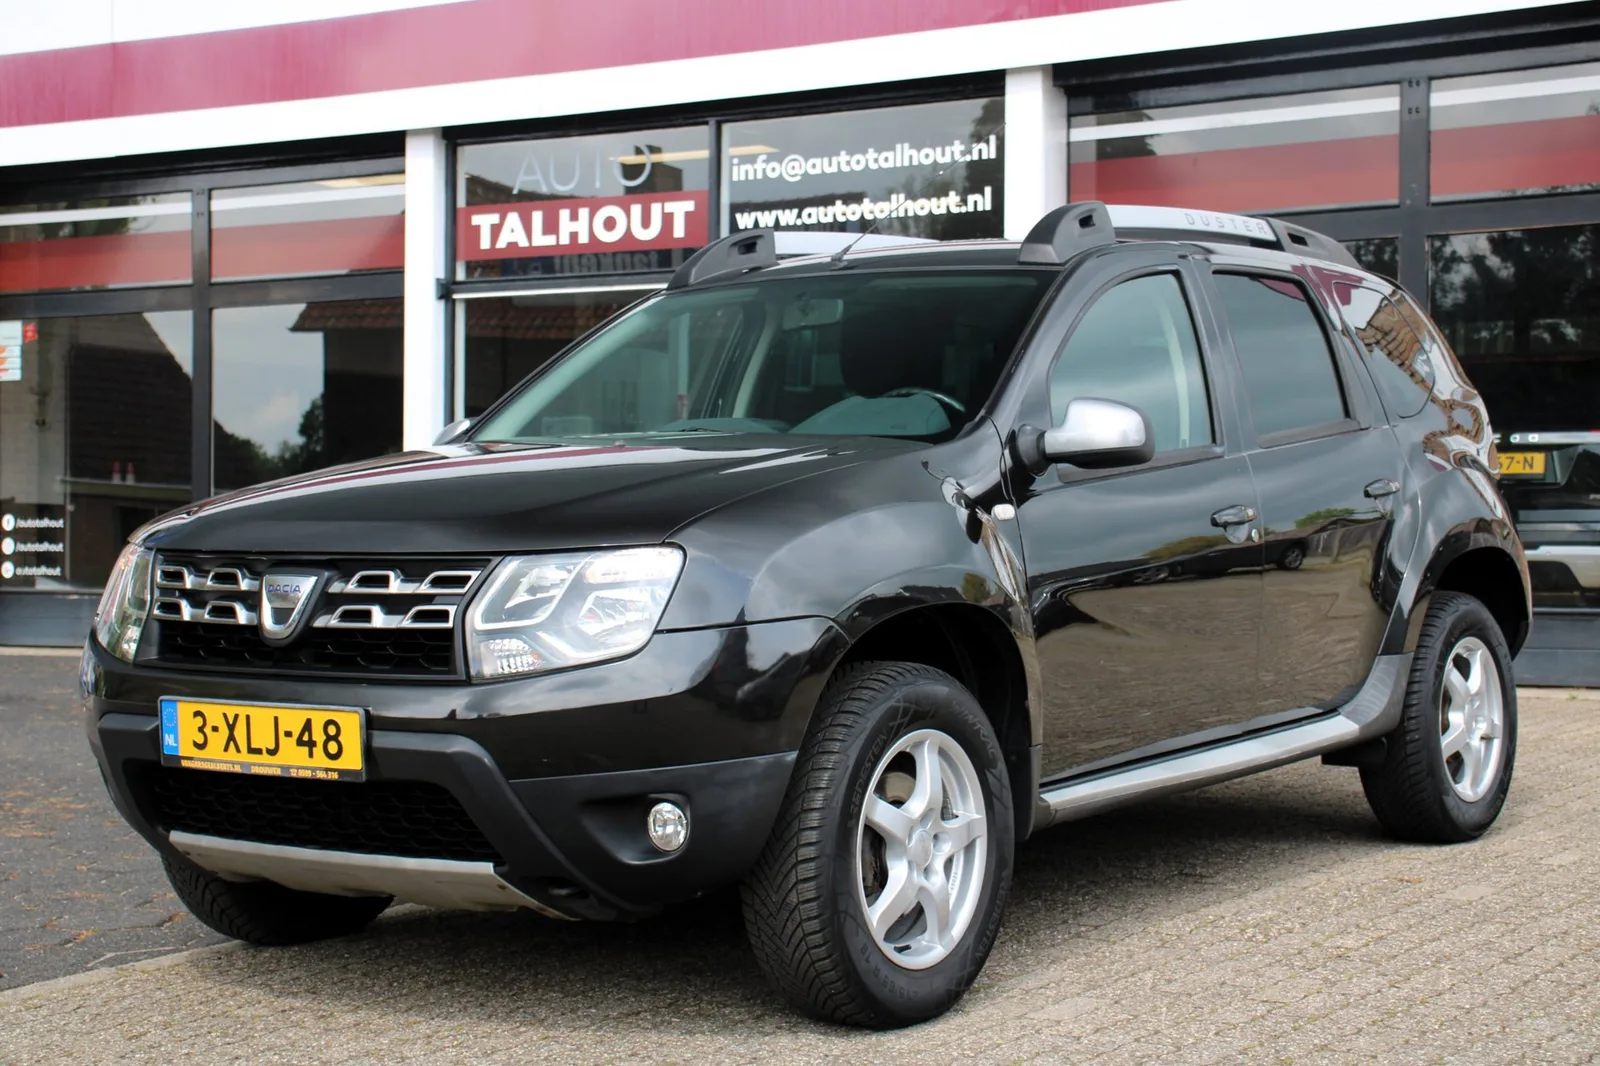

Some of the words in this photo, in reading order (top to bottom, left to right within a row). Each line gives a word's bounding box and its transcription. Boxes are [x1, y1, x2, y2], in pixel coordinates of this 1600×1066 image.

[512, 143, 652, 195] AUTO
[731, 135, 996, 182] info@autotalhout.nl
[471, 200, 695, 250] TALHOUT
[735, 186, 992, 230] www.autotalhout.nl
[1184, 213, 1268, 235] DUSTER
[267, 584, 301, 594] DACIA
[164, 734, 178, 747] NL
[192, 709, 344, 761] 3-XLJ-48
[847, 729, 889, 829] VREDESTEIN
